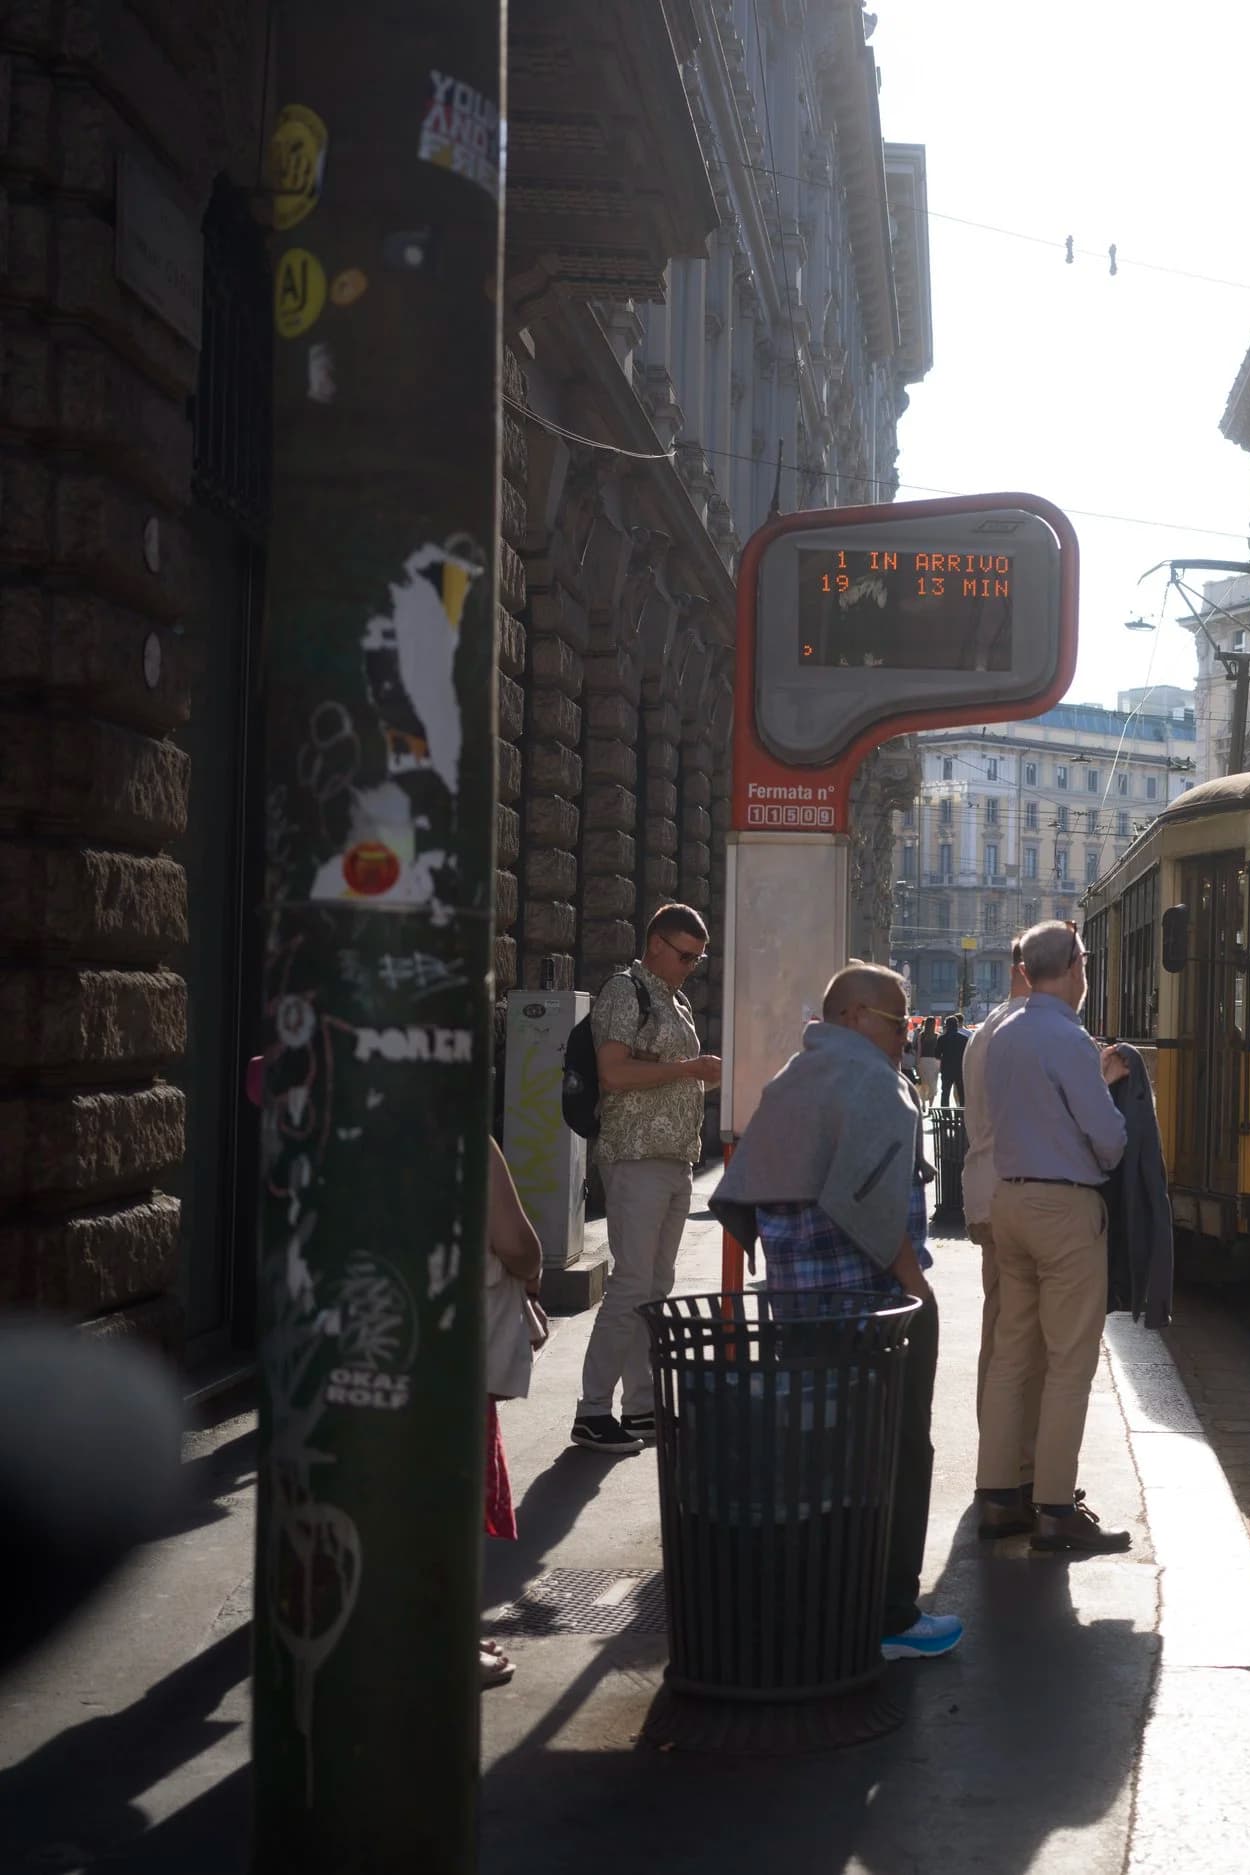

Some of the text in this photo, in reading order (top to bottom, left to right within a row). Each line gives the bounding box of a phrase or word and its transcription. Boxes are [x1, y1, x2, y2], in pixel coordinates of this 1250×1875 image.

[837, 551, 1010, 573] 1 IN ARRIVO
[820, 573, 1009, 597] 19 13 MIN
[748, 783, 835, 801] Fermata n°
